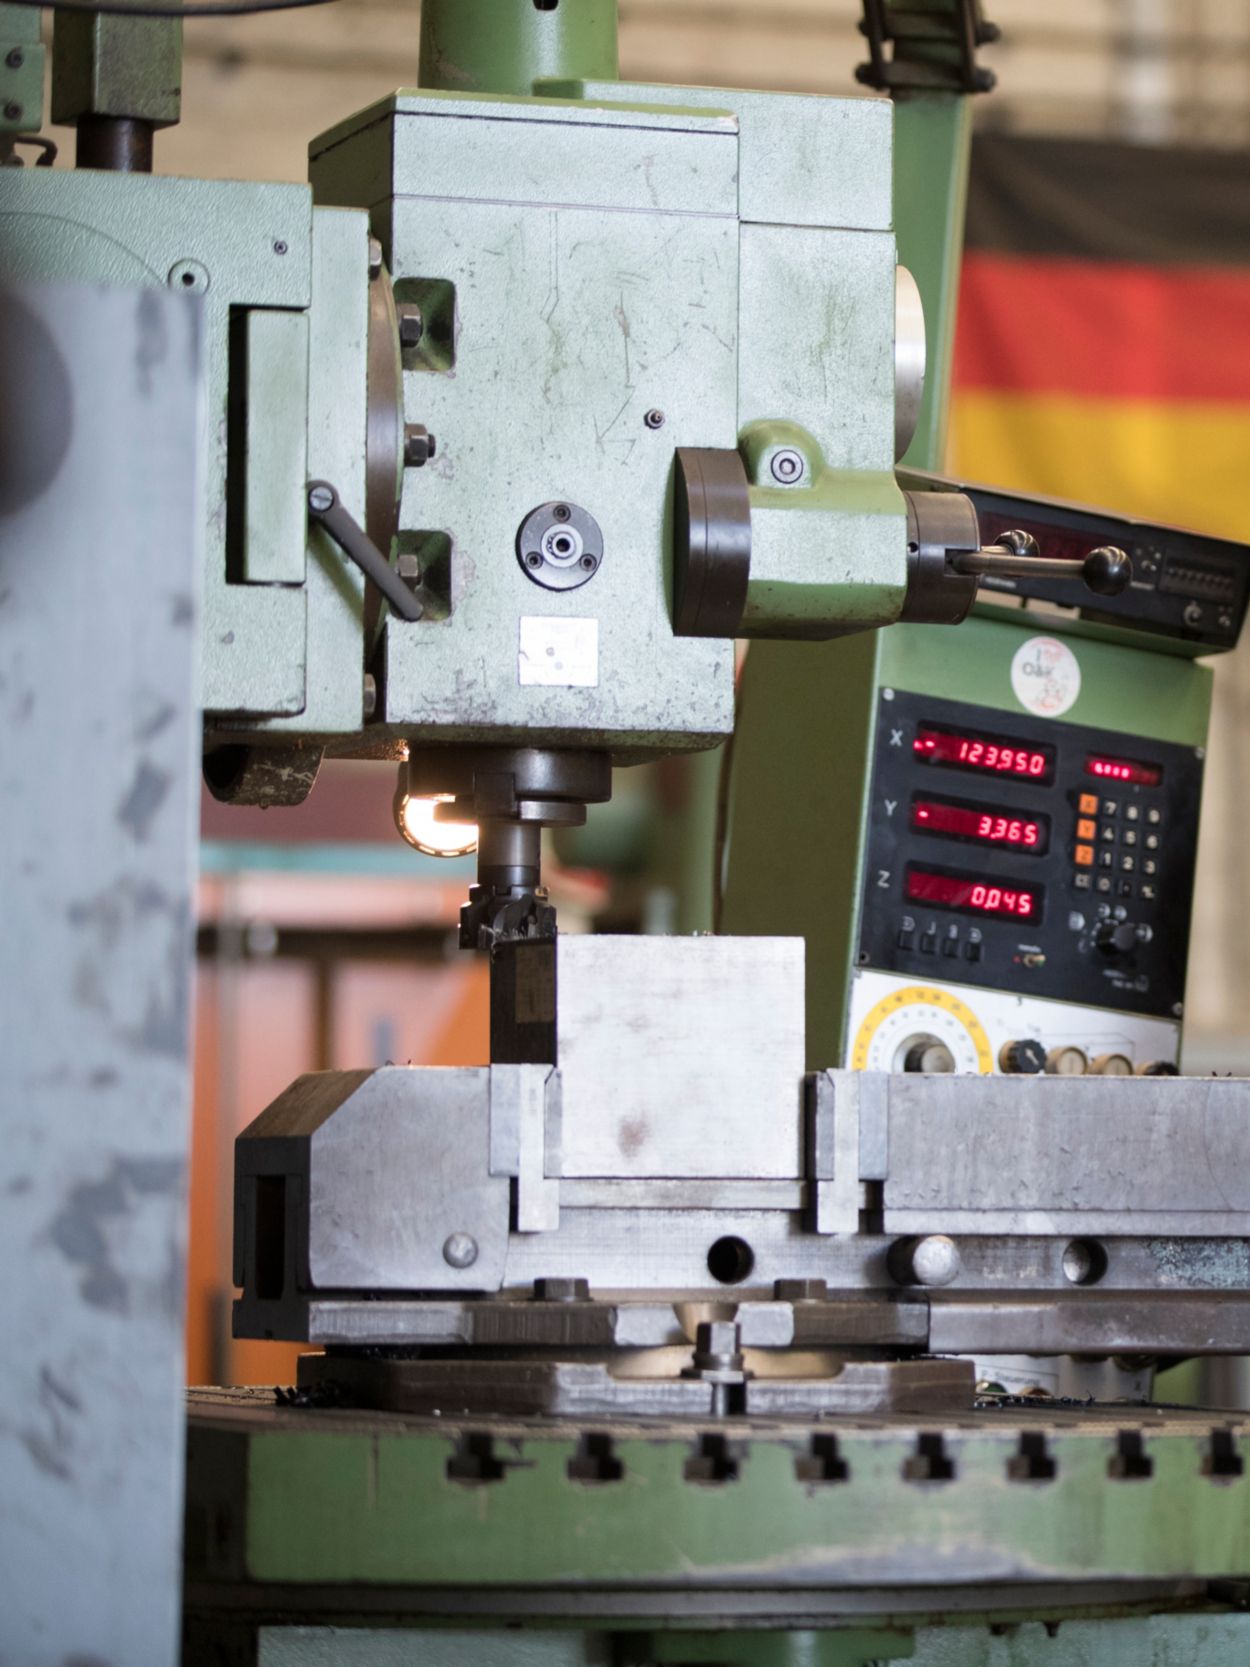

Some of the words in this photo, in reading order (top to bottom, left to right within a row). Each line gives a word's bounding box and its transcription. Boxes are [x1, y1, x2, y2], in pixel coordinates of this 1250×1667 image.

[889, 728, 903, 746] X
[884, 799, 898, 816] Y
[877, 870, 891, 888] Z
